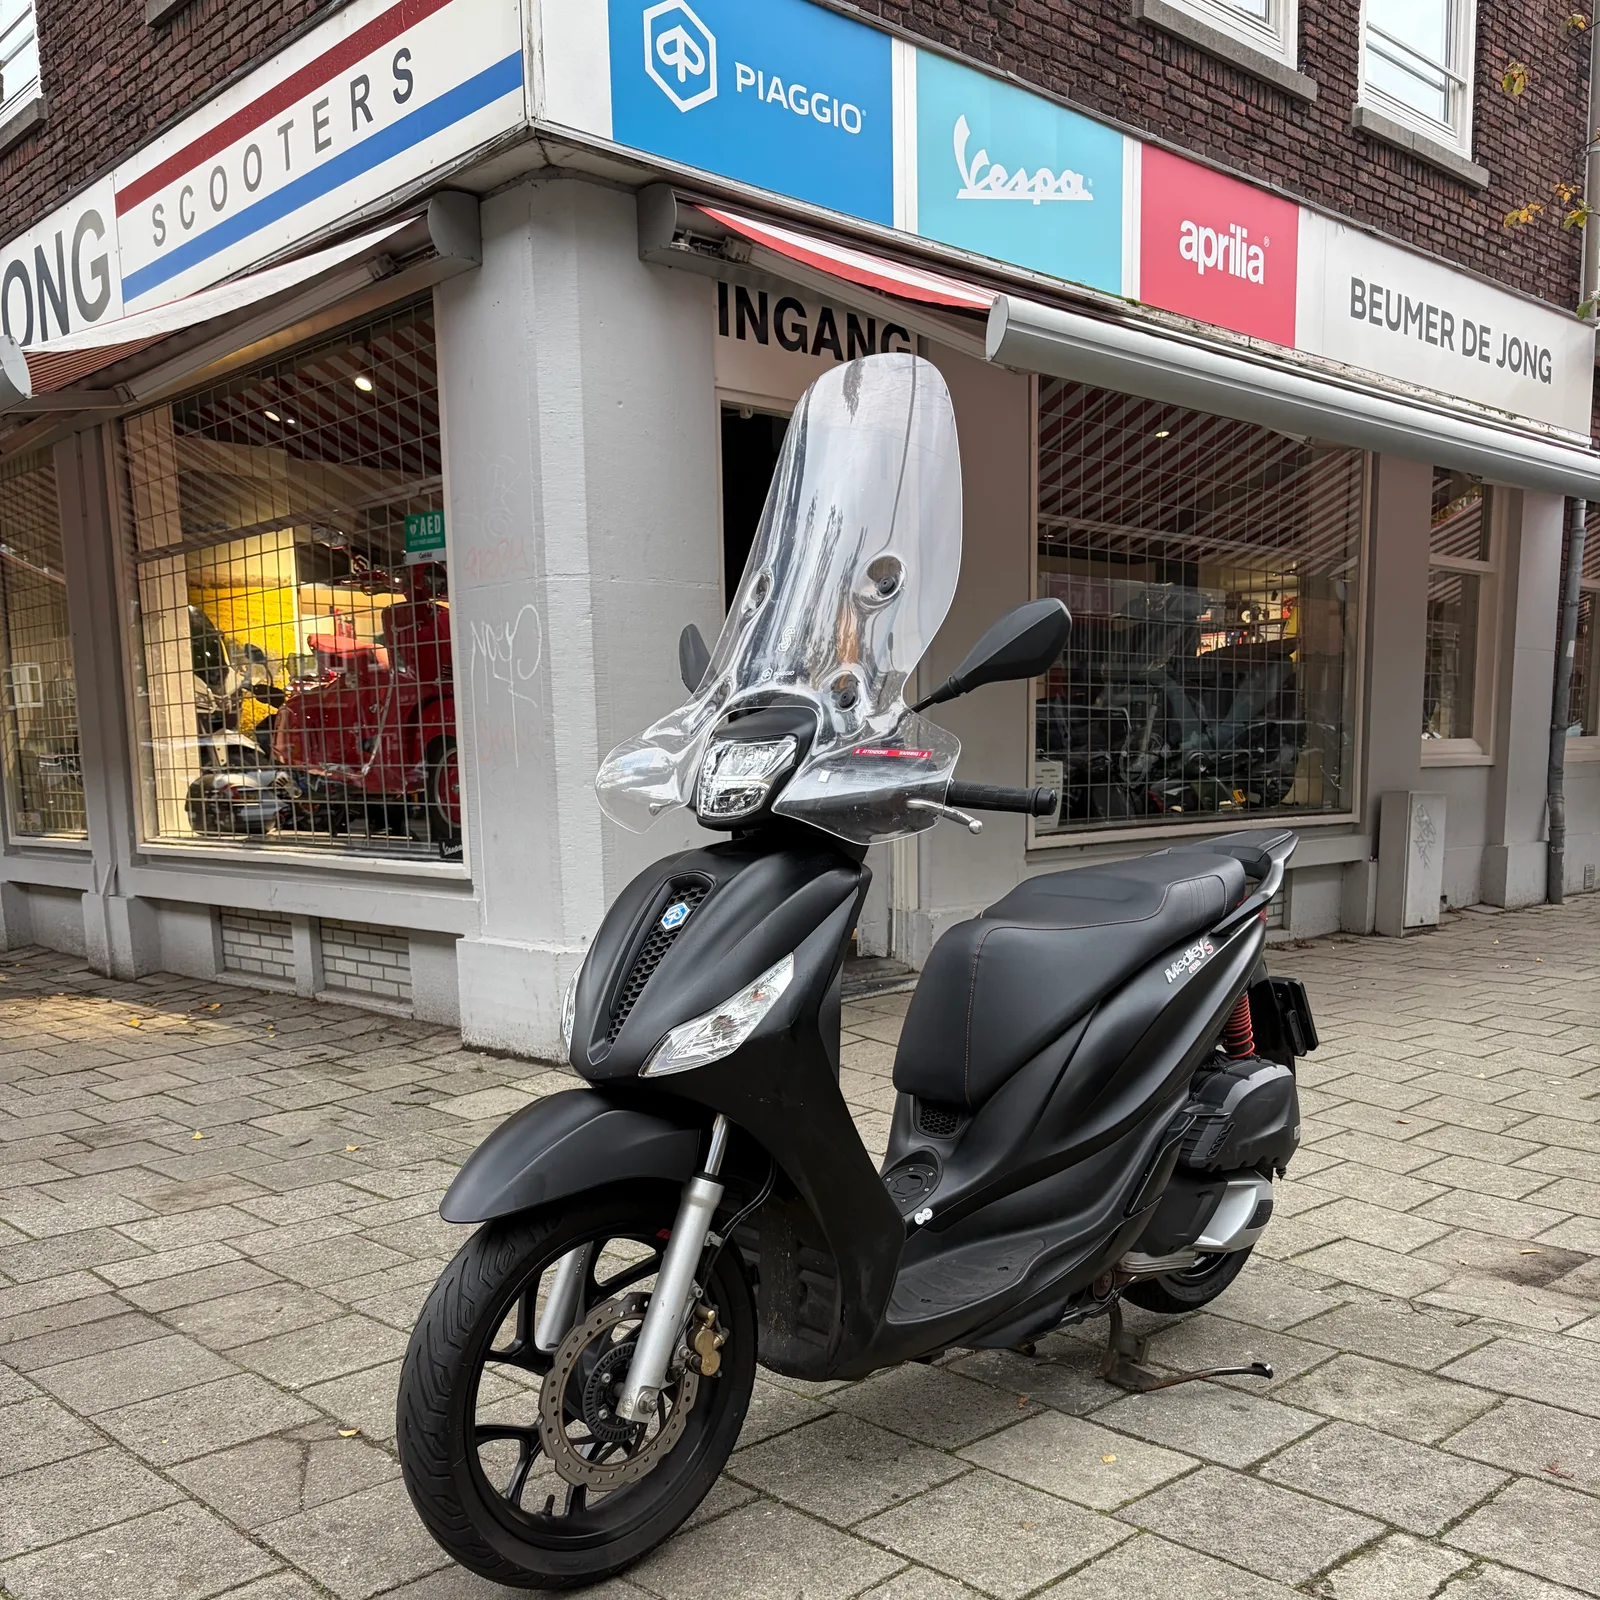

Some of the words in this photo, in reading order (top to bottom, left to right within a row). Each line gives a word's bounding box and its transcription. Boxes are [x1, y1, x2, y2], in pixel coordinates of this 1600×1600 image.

[734, 61, 862, 134] PIAGGIO
[152, 47, 414, 247] SCOOTERS
[953, 114, 1094, 205] Vespa
[1179, 220, 1265, 285] aprilia
[717, 281, 911, 362] INGANG
[1350, 276, 1455, 352] BEUMER
[1461, 318, 1492, 364] DE
[1496, 332, 1552, 385] JONG
[419, 514, 441, 536] AED
[1164, 938, 1205, 984] Medley
